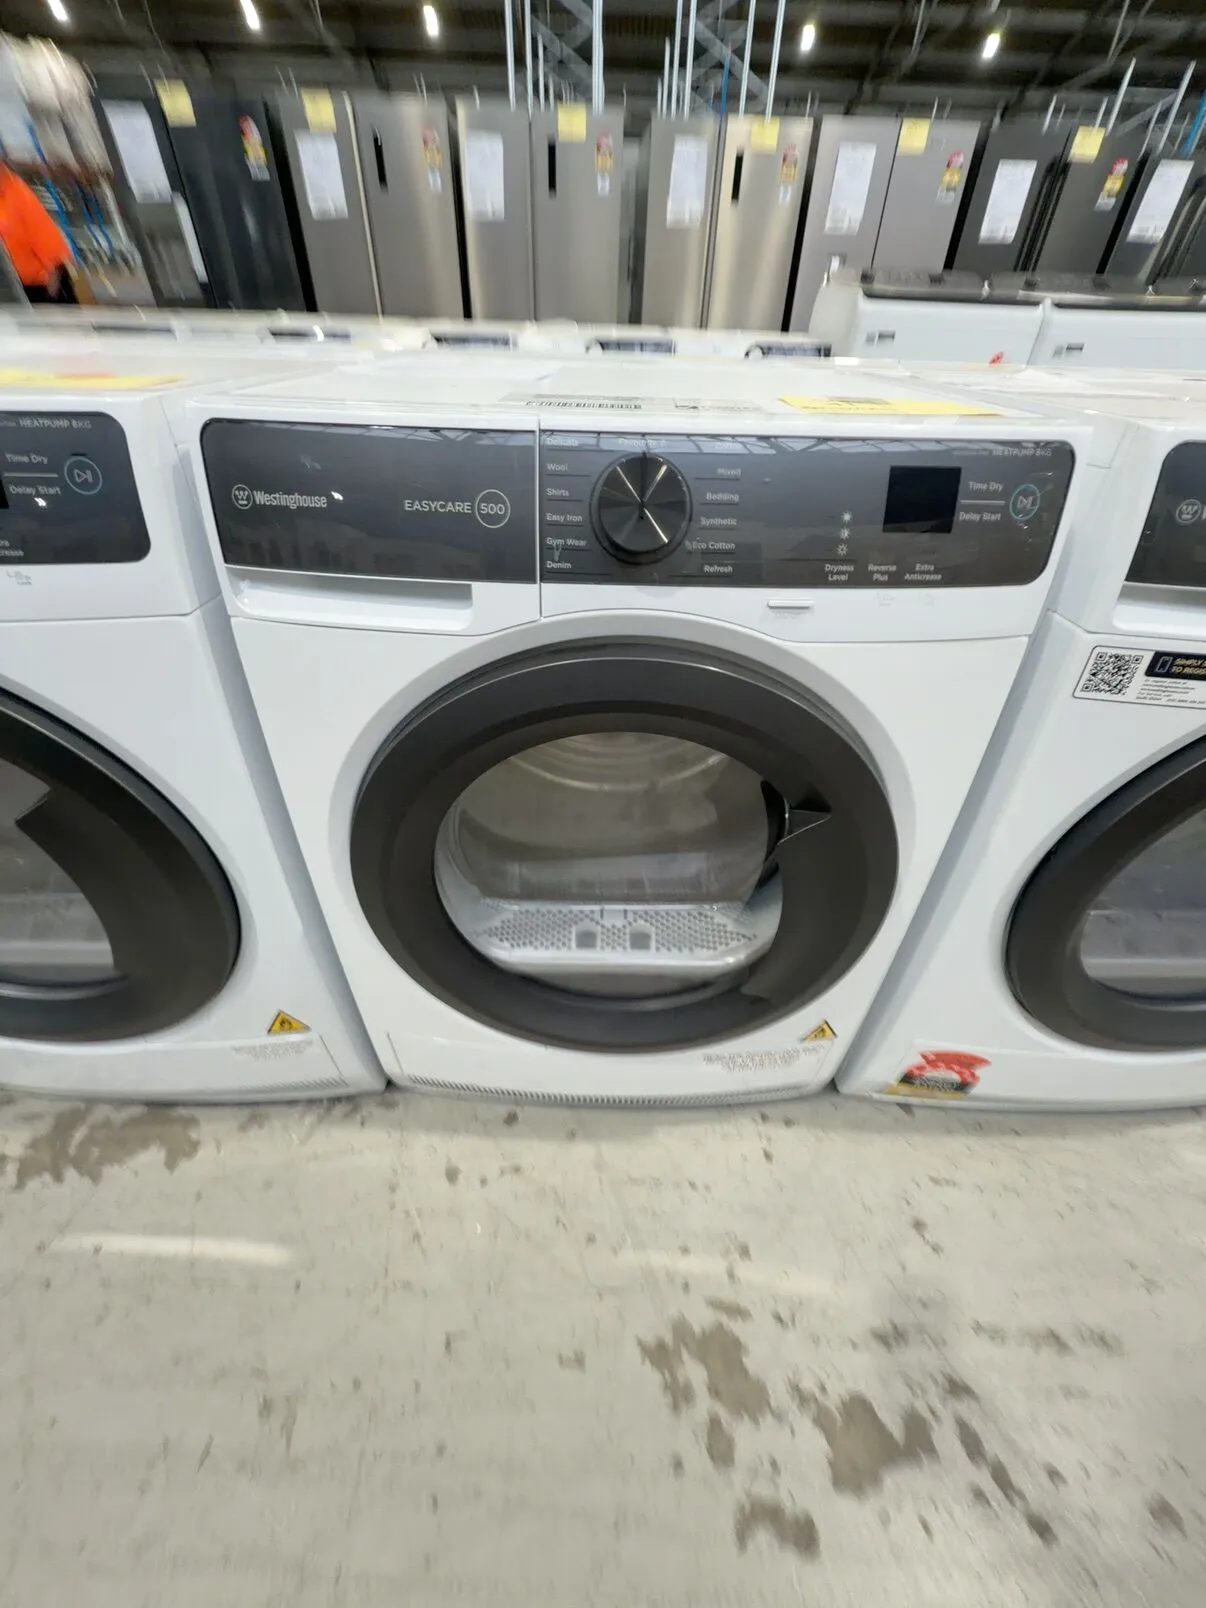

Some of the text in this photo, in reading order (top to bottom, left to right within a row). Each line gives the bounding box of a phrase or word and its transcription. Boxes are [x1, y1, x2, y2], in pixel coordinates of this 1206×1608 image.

[5, 452, 49, 465] Time Dry
[546, 462, 568, 472] Wool
[717, 467, 742, 477] Mixed
[9, 484, 62, 496] Delay Start
[968, 481, 1005, 493] Time Dry
[546, 487, 570, 498] Shirts
[706, 491, 740, 502] Bedding
[253, 490, 328, 510] Westinghouse
[404, 499, 506, 515] EASYCARE 500
[546, 513, 583, 523] Easy Iron
[699, 516, 737, 527] Synthetic
[959, 511, 1002, 522] Delay Start
[546, 537, 588, 547] Gym Wear
[707, 541, 736, 550] Cotton
[546, 560, 572, 569] Denim
[703, 564, 733, 574] Refresh
[824, 564, 855, 573] Dryness
[867, 563, 897, 572] Reverse
[914, 563, 935, 572] Extra
[827, 573, 849, 582] Level
[872, 573, 889, 582] Plus
[903, 572, 943, 582] Anticrease
